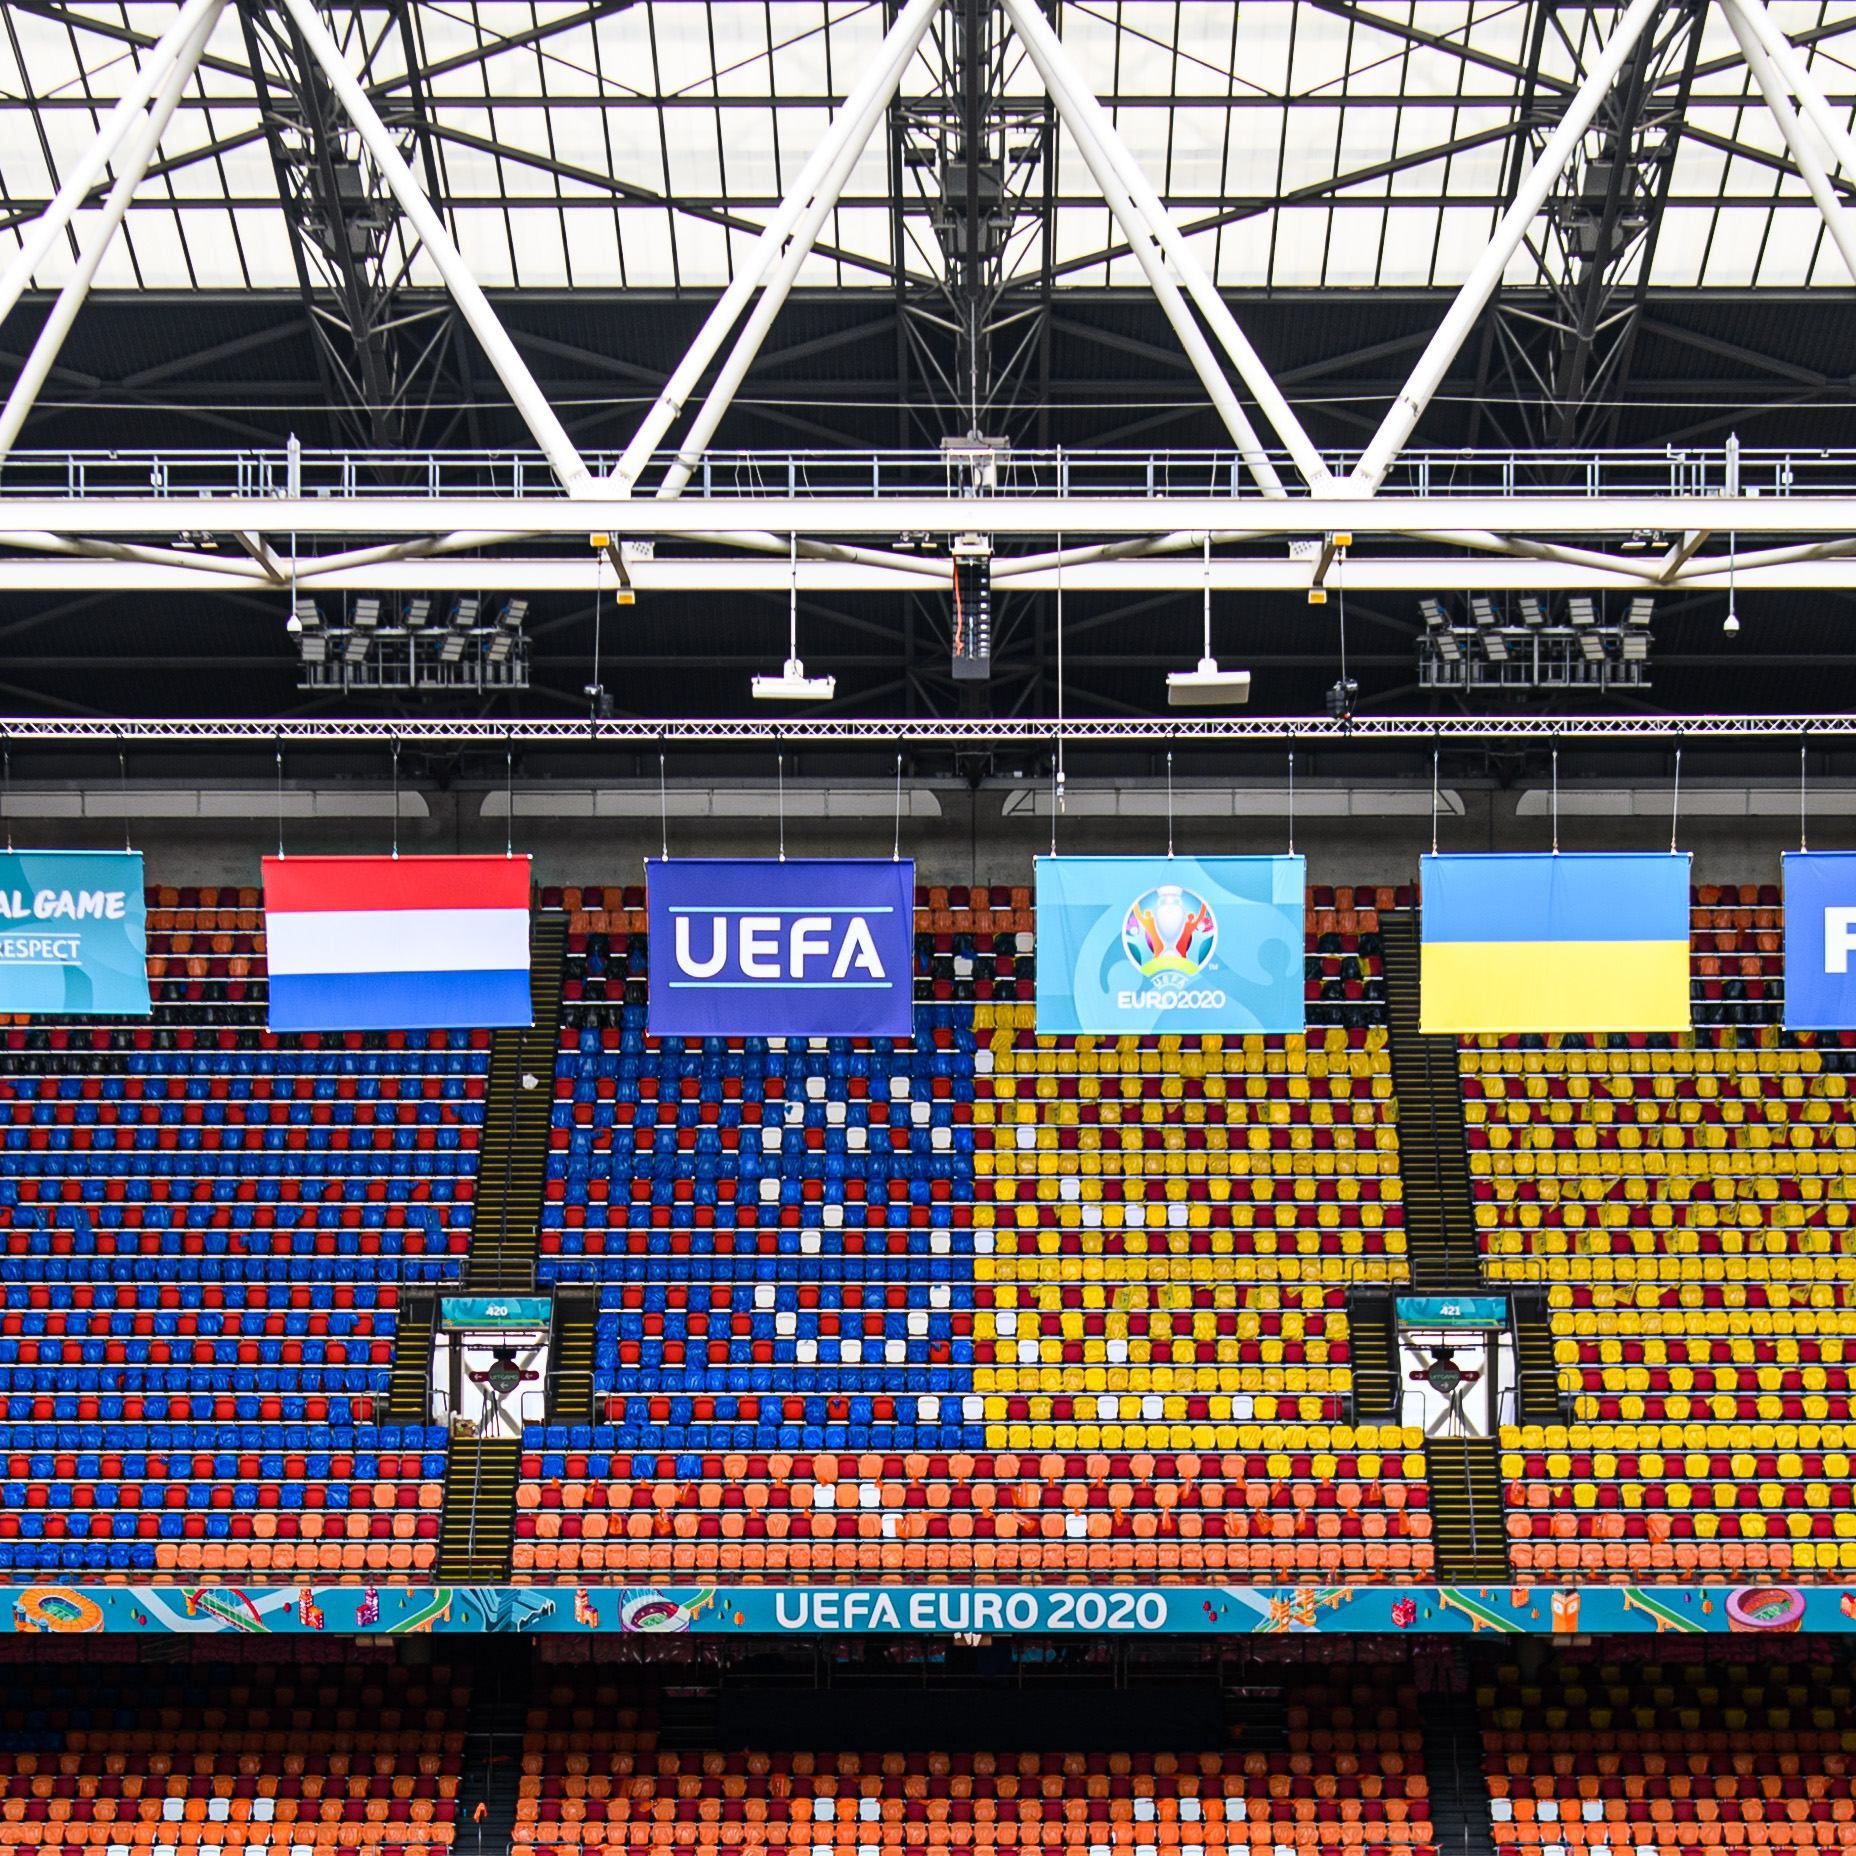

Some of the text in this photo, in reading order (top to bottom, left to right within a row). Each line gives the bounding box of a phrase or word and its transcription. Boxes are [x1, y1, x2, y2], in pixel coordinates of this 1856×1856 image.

[33, 889, 127, 920] GAME
[675, 916, 886, 978] UEFA
[1151, 973, 1188, 989] UEFA
[486, 1305, 508, 1316] 420
[1440, 1305, 1461, 1316] 421
[776, 1592, 1168, 1629] UEFA EURO 2020
